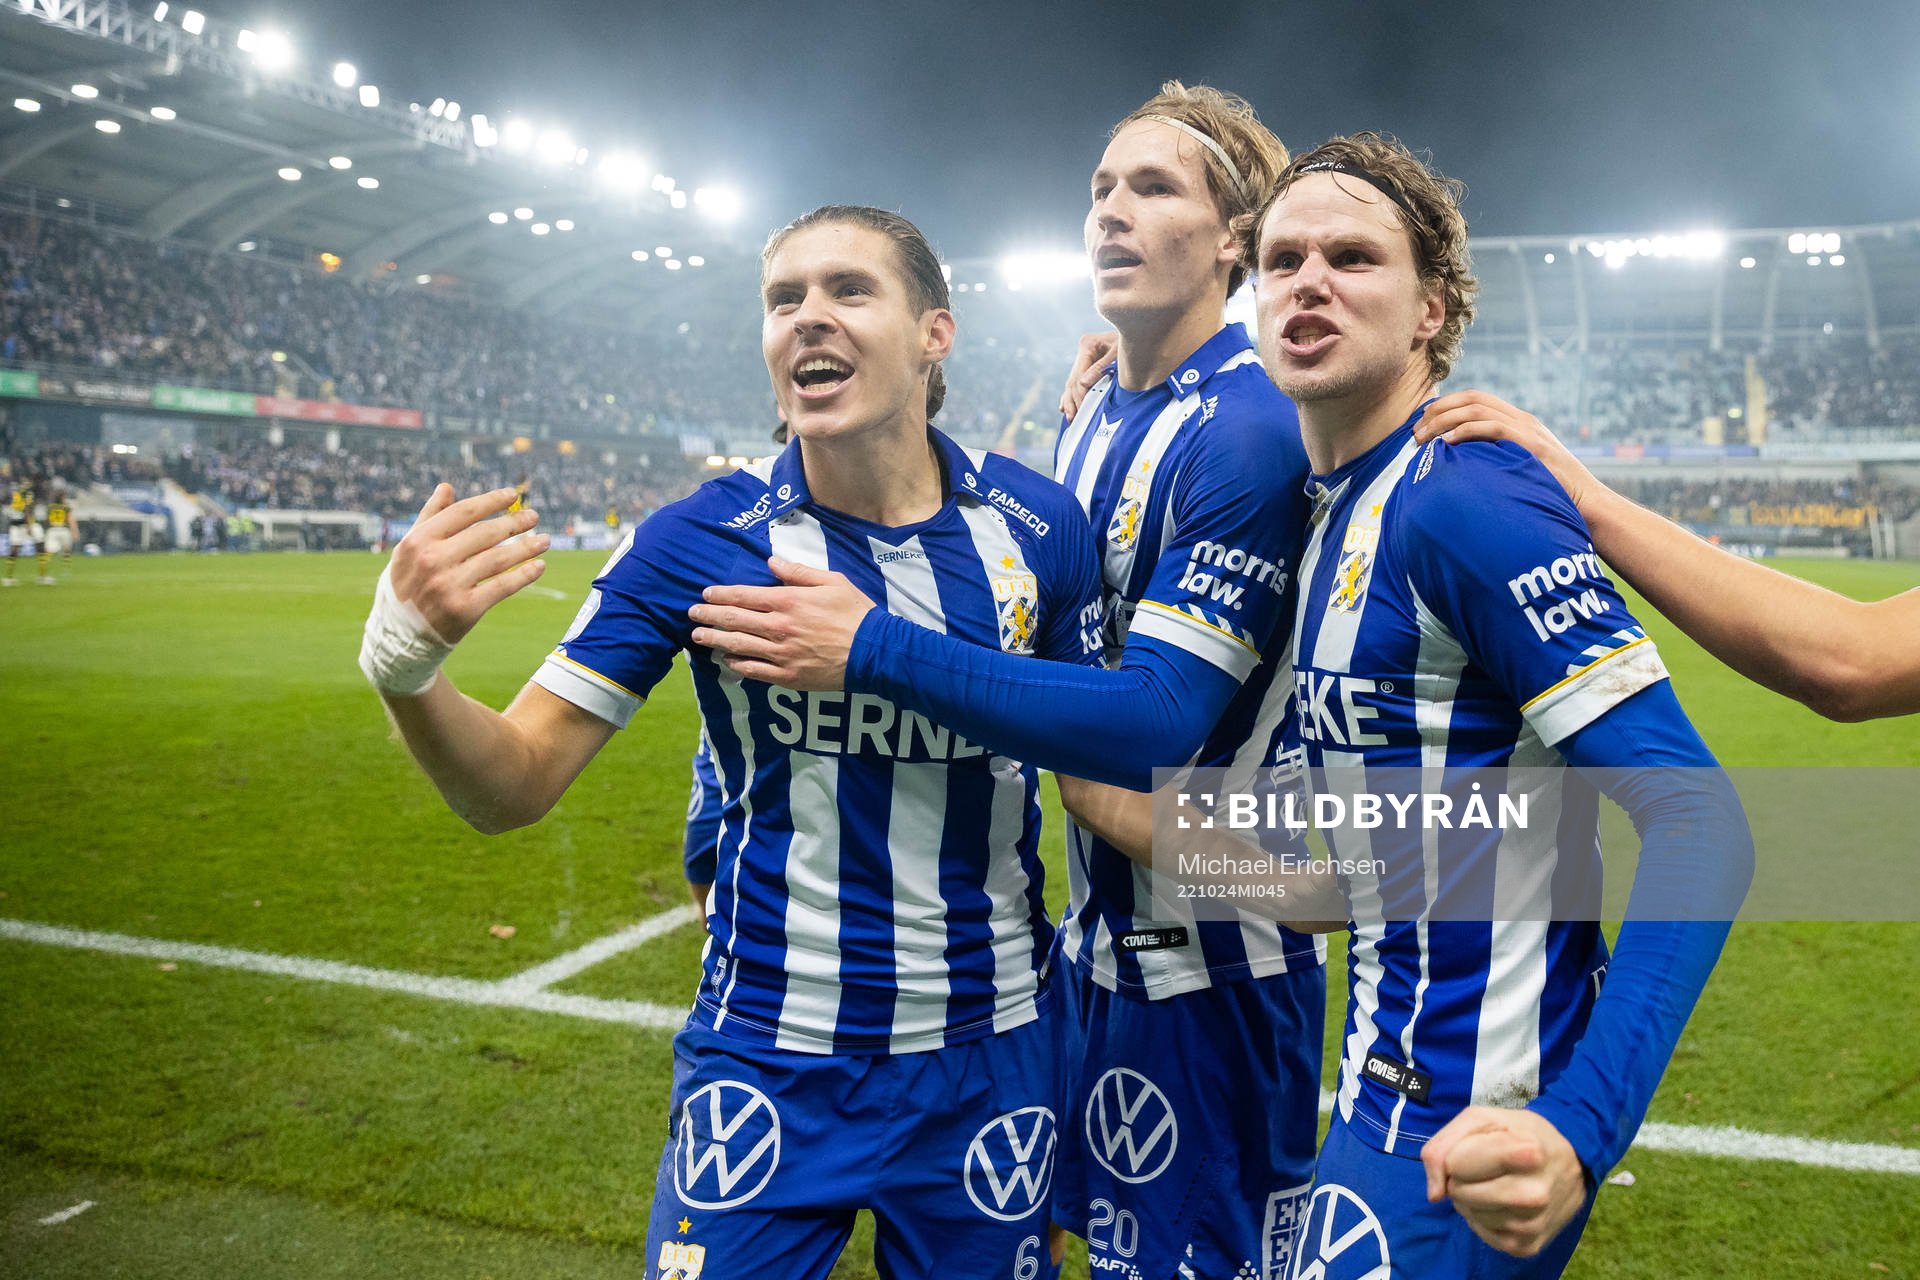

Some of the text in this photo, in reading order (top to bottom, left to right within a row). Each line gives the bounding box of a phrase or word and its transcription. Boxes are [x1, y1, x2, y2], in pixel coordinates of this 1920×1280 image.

[988, 487, 1050, 537] FAMECO
[1177, 560, 1243, 611] law.
[1191, 540, 1289, 596] morris
[1508, 542, 1604, 607] morri
[1523, 587, 1610, 643] law.
[1086, 1197, 1139, 1259] 20
[1013, 1235, 1041, 1280] 6
[1088, 1253, 1131, 1275] RAFT
